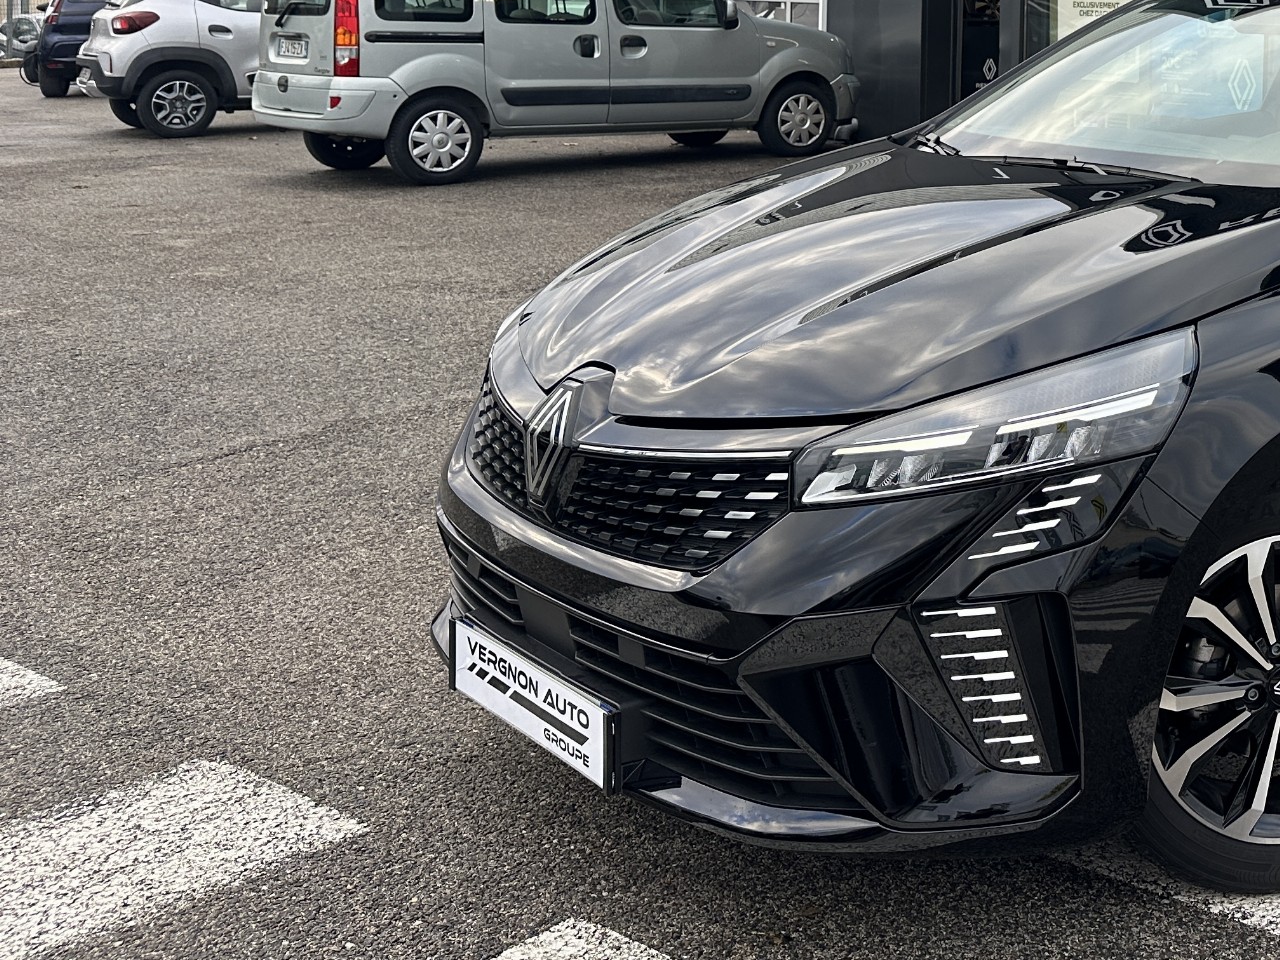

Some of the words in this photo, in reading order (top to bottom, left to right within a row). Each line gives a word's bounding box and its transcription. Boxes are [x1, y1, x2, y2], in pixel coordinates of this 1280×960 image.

[1072, 0, 1120, 10] EXCLUSIVEMENT
[466, 635, 539, 699] VERGNON
[542, 688, 590, 730] AUTO
[543, 727, 590, 769] GROUPE
